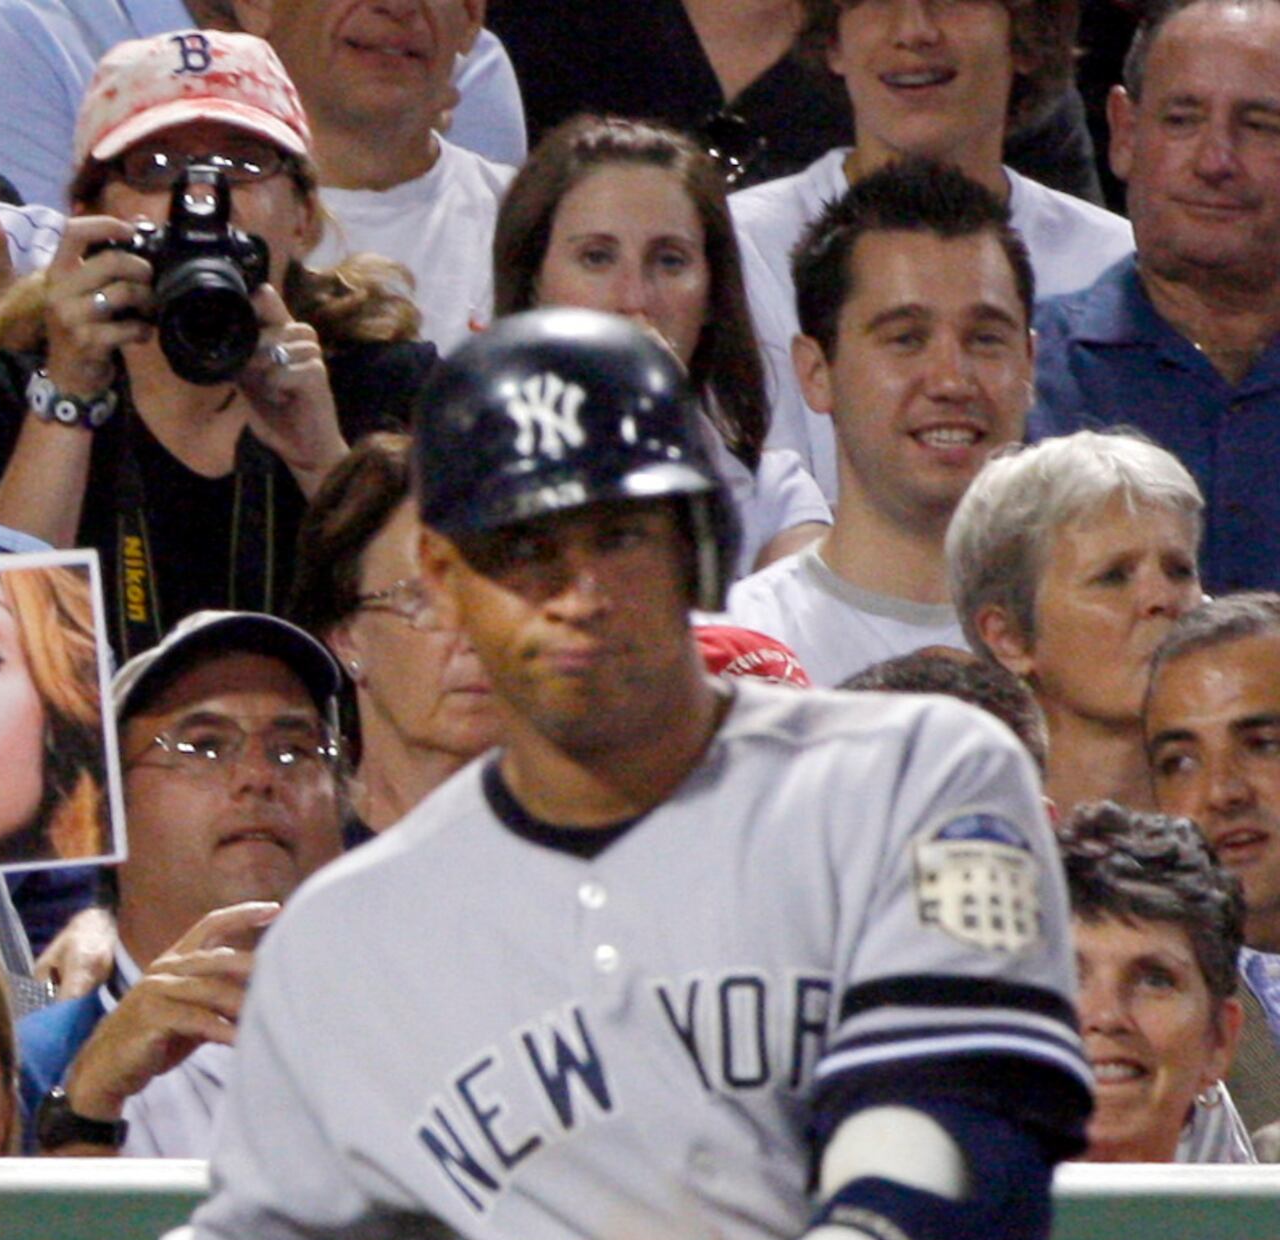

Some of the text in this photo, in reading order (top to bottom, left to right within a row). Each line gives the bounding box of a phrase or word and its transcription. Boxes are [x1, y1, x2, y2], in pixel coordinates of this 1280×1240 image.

[170, 33, 213, 74] B
[506, 371, 587, 462] NY
[417, 975, 832, 1212] NEW YOR
